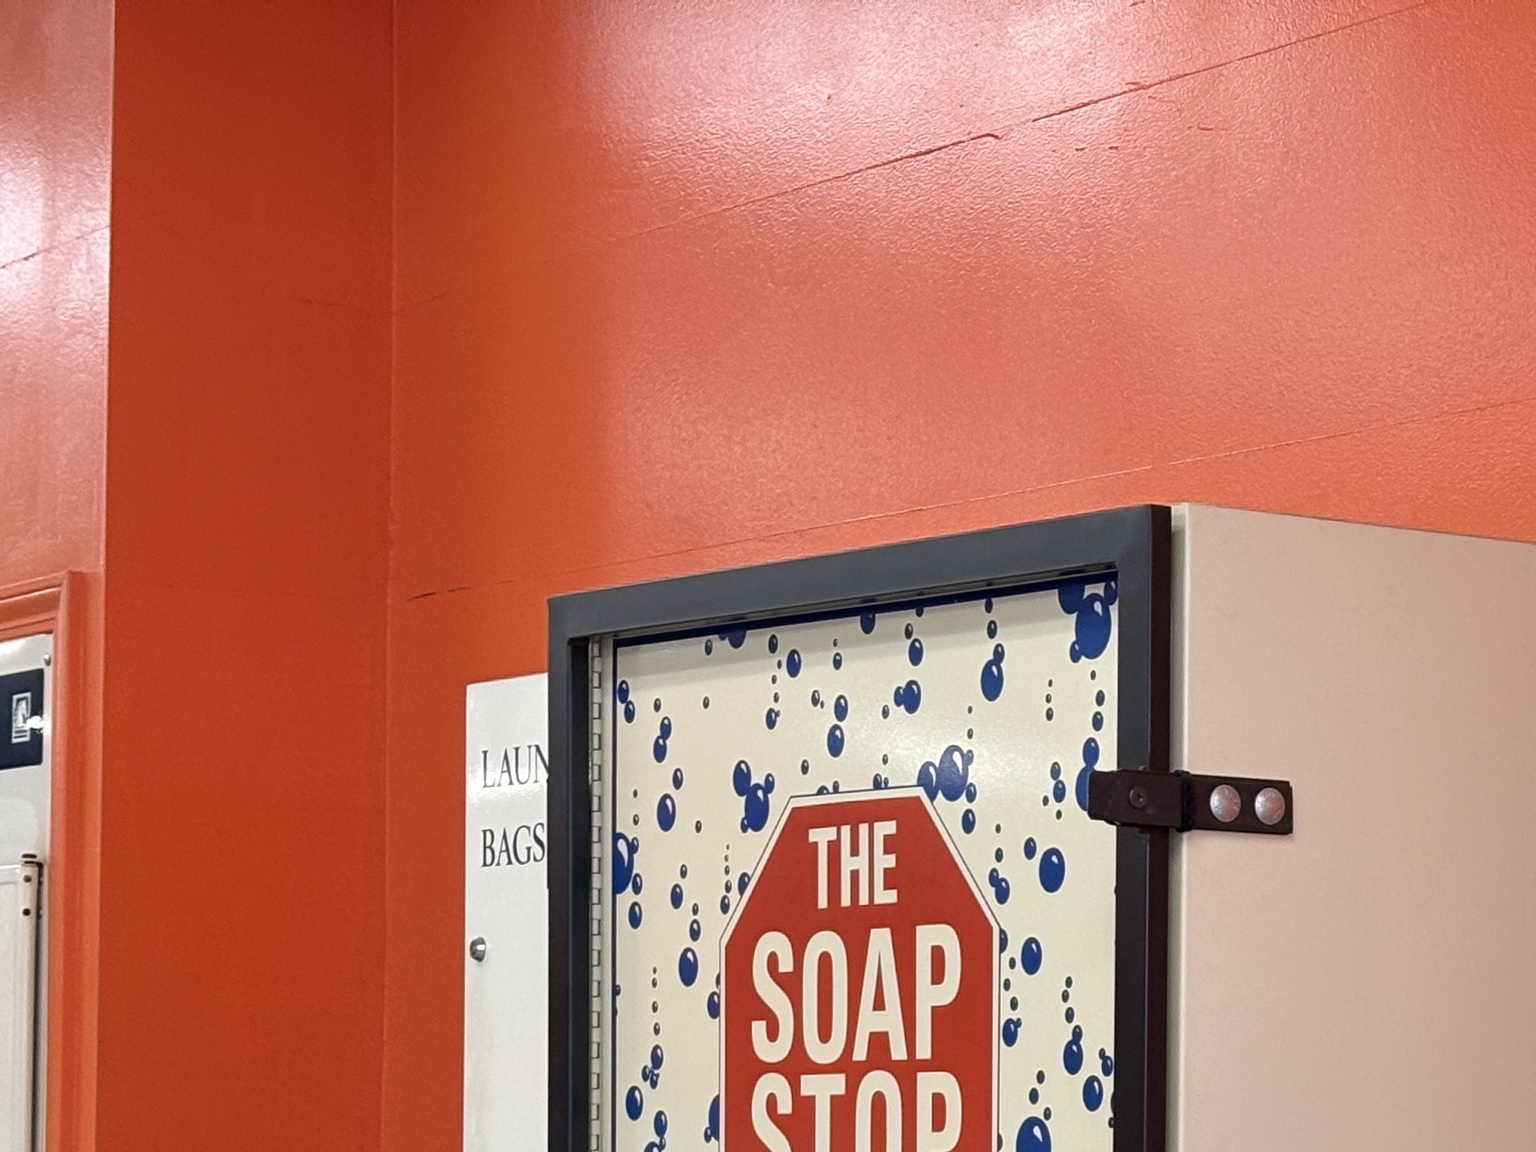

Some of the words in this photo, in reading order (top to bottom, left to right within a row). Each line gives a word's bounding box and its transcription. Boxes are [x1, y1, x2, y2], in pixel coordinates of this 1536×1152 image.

[481, 822, 546, 868] BAGS
[808, 819, 898, 909] THE
[750, 923, 963, 1065] SOAP
